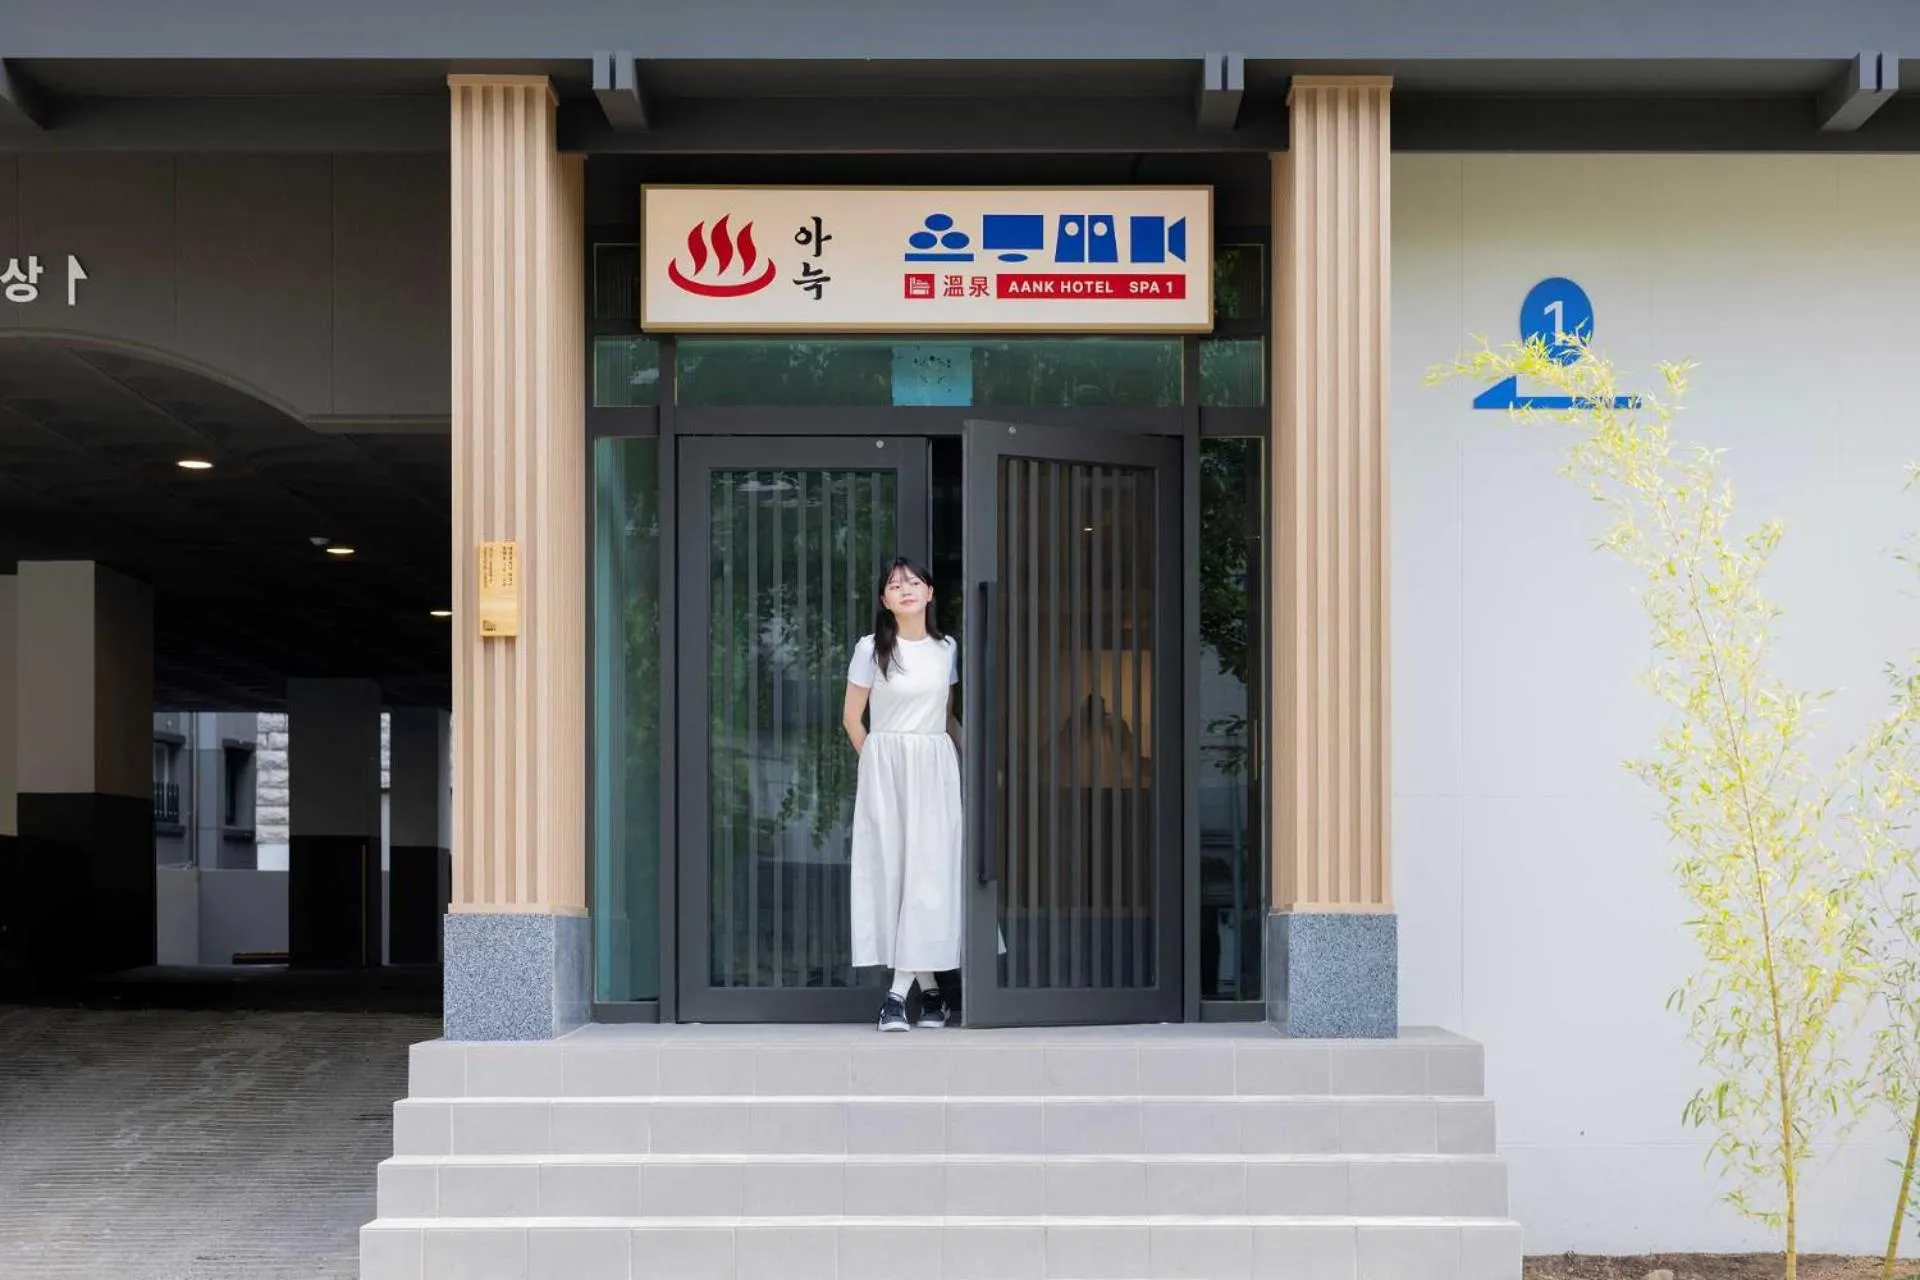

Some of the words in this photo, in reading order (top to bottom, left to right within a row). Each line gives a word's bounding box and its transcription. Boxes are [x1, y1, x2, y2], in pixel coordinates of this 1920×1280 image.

[0, 255, 44, 303] 상
[792, 215, 833, 301] 아늑
[1008, 280, 1054, 293] AANK
[1060, 280, 1114, 293] HOTEL
[1129, 280, 1160, 293] SPA
[1166, 280, 1173, 293] 1
[1543, 300, 1564, 347] 1
